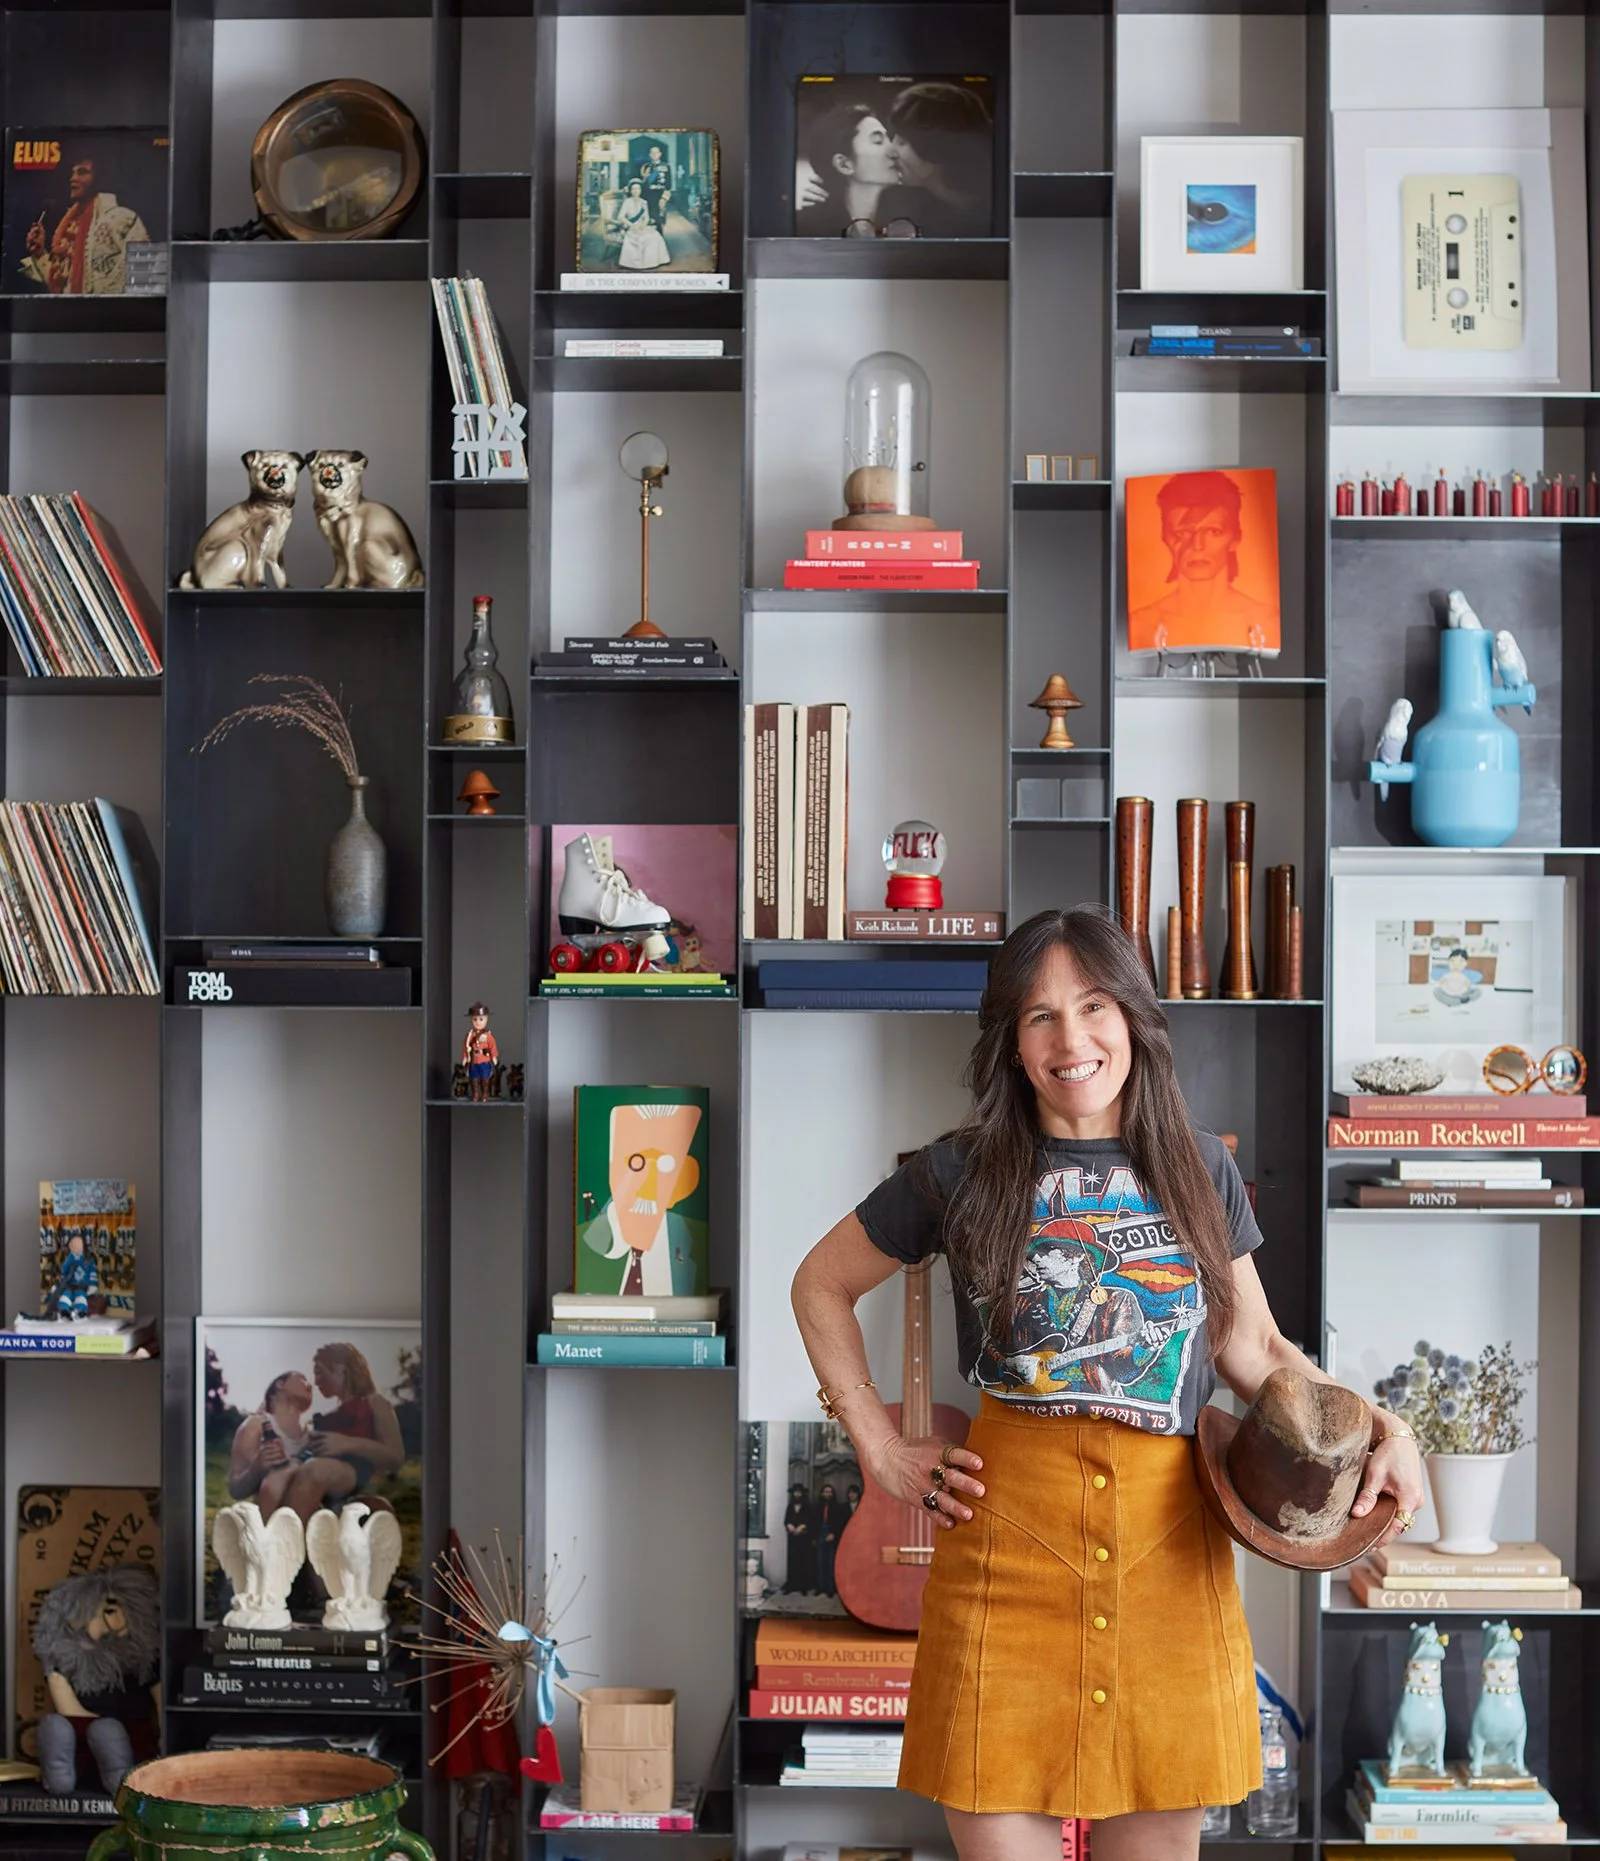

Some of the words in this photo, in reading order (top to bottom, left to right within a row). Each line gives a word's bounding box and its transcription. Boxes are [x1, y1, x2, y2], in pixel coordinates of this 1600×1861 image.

[585, 278, 595, 287] IN
[598, 278, 617, 287] THE
[617, 278, 659, 287] COMPANY
[660, 278, 672, 287] OF
[674, 278, 708, 287] WOMEN
[892, 831, 940, 859] FUCK
[855, 920, 880, 932] Keith
[881, 919, 919, 932] Richards
[926, 917, 977, 936] LIFE
[187, 971, 225, 987] TOM
[188, 985, 233, 1000] FORD
[1367, 1103, 1388, 1112] ANNIE
[1333, 1123, 1419, 1145] Norman
[1430, 1123, 1526, 1145] Rockwell
[1409, 1192, 1457, 1206] PRINTS
[620, 1325, 656, 1333] CANADIAN
[658, 1326, 698, 1334] COLLECTION
[41, 1339, 73, 1349] KOOP
[554, 1343, 603, 1358] Manet
[1090, 1405, 1143, 1428] TOUR
[1146, 1411, 1167, 1429] '78
[36, 1538, 46, 1560] NO
[1380, 1591, 1448, 1608] GOYA
[225, 1633, 249, 1651] John
[249, 1633, 283, 1651] Lennon
[769, 1648, 829, 1662] WORLD
[831, 1649, 916, 1663] ARCHITEC
[256, 1658, 274, 1669] THE
[274, 1658, 312, 1670] BEATLES
[203, 1672, 243, 1695] BEATLES
[802, 1672, 880, 1688] Rembrandt
[33, 1684, 46, 1713] YES
[769, 1696, 843, 1716] JULIAN
[11, 1799, 80, 1813] FITZGERALD
[577, 1815, 584, 1828] I
[590, 1816, 615, 1829] AM
[621, 1816, 660, 1830] HERE
[1416, 1808, 1480, 1823] Farmlife
